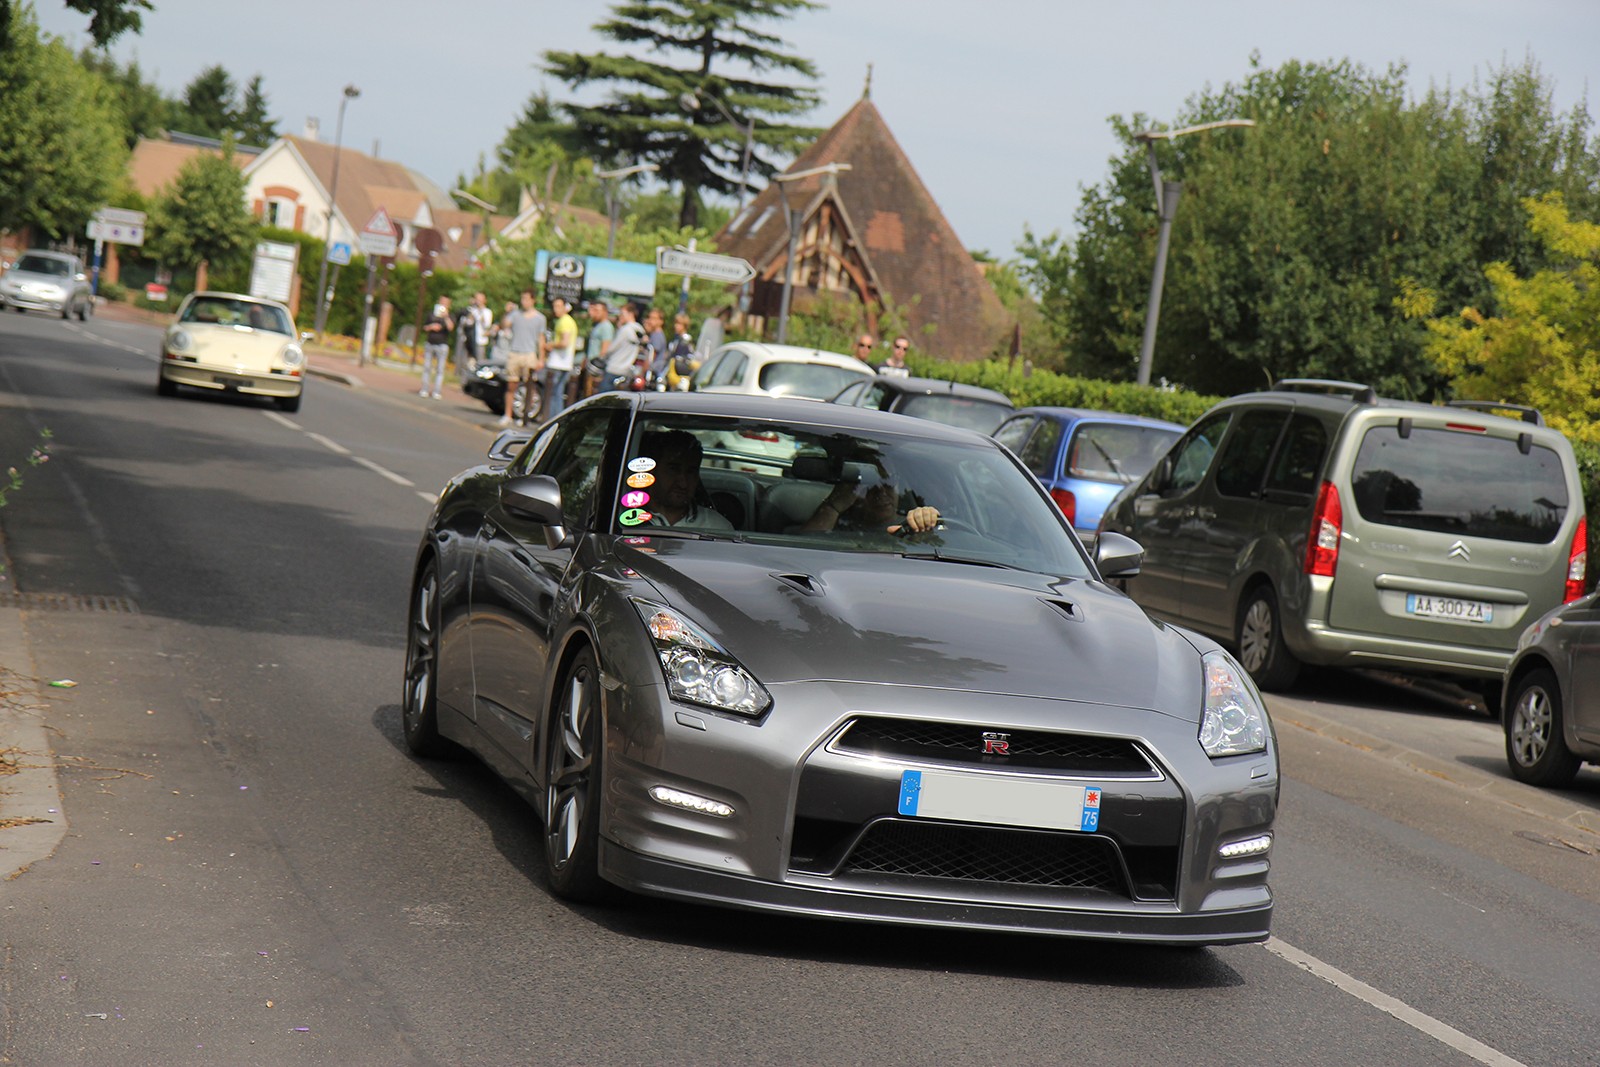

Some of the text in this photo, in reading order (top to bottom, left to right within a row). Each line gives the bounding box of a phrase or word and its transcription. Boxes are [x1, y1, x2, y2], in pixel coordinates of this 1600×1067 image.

[627, 493, 644, 503] N
[625, 510, 637, 520] J
[1416, 598, 1483, 618] AA 300 ZA
[982, 731, 1011, 740] GT
[982, 739, 1010, 755] R
[905, 796, 913, 806] F
[1083, 811, 1098, 826] 75
